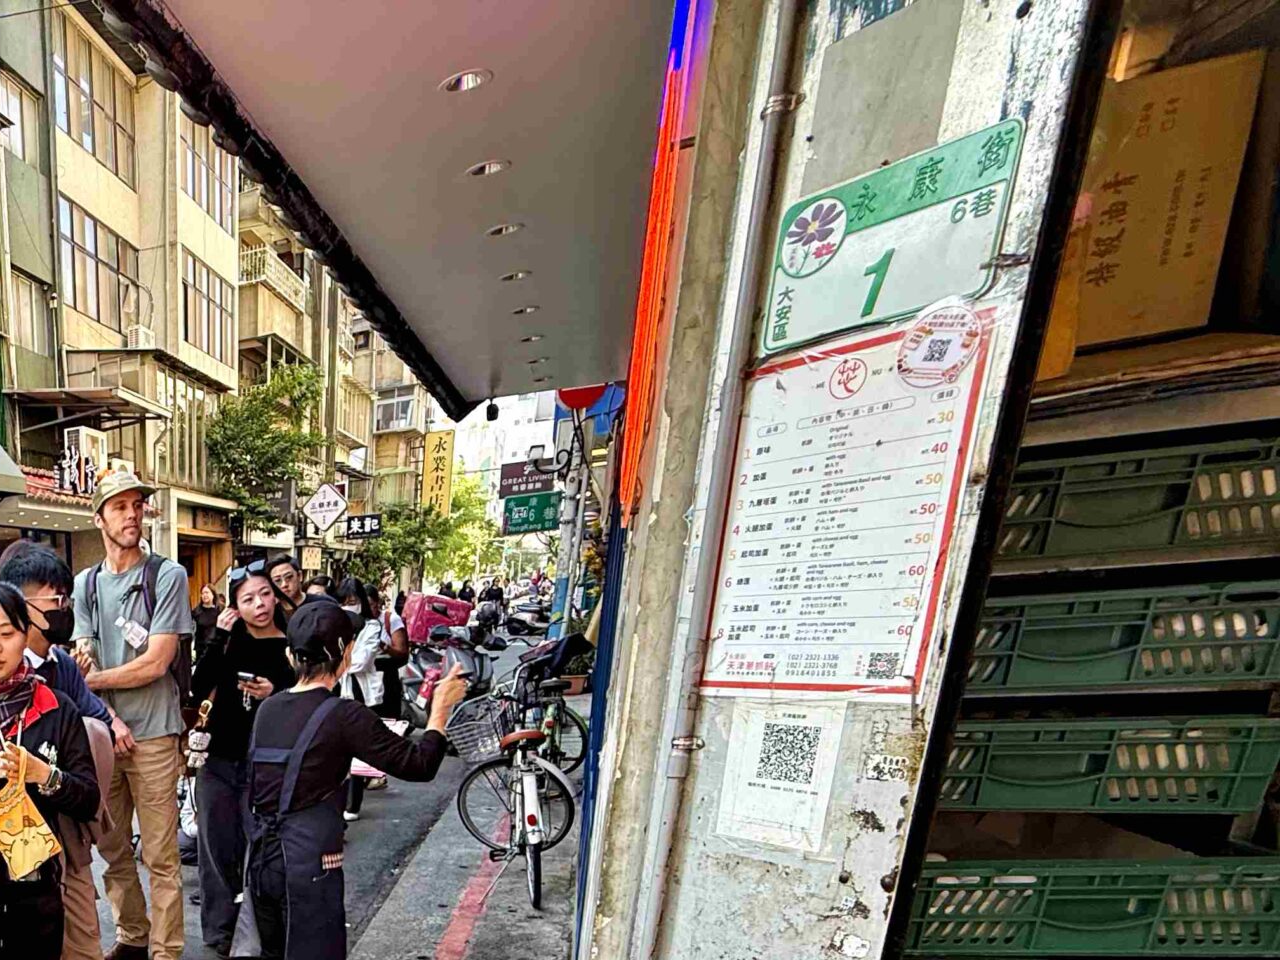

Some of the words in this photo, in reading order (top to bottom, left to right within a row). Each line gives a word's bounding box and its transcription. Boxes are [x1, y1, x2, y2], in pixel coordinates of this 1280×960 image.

[850, 127, 1015, 222] 永康街
[951, 188, 997, 224] 6巷
[861, 248, 895, 318] 1
[772, 286, 795, 342] 大安區
[938, 410, 954, 423] 30
[931, 442, 948, 454] 40
[744, 449, 751, 459] 1
[502, 477, 527, 486] GREAT
[528, 473, 553, 482] LIVING
[740, 474, 748, 485] 2
[926, 473, 942, 484] 50
[736, 500, 744, 510] 3
[919, 503, 936, 515] 50
[529, 509, 535, 521] 6
[349, 517, 379, 534] 朱記
[733, 525, 740, 535] 4
[914, 533, 930, 544] 50
[729, 550, 736, 560] 5
[909, 565, 924, 576] 60
[725, 577, 732, 588] 6
[722, 604, 729, 614] 7
[718, 629, 724, 639] 8
[897, 625, 913, 636] 60
